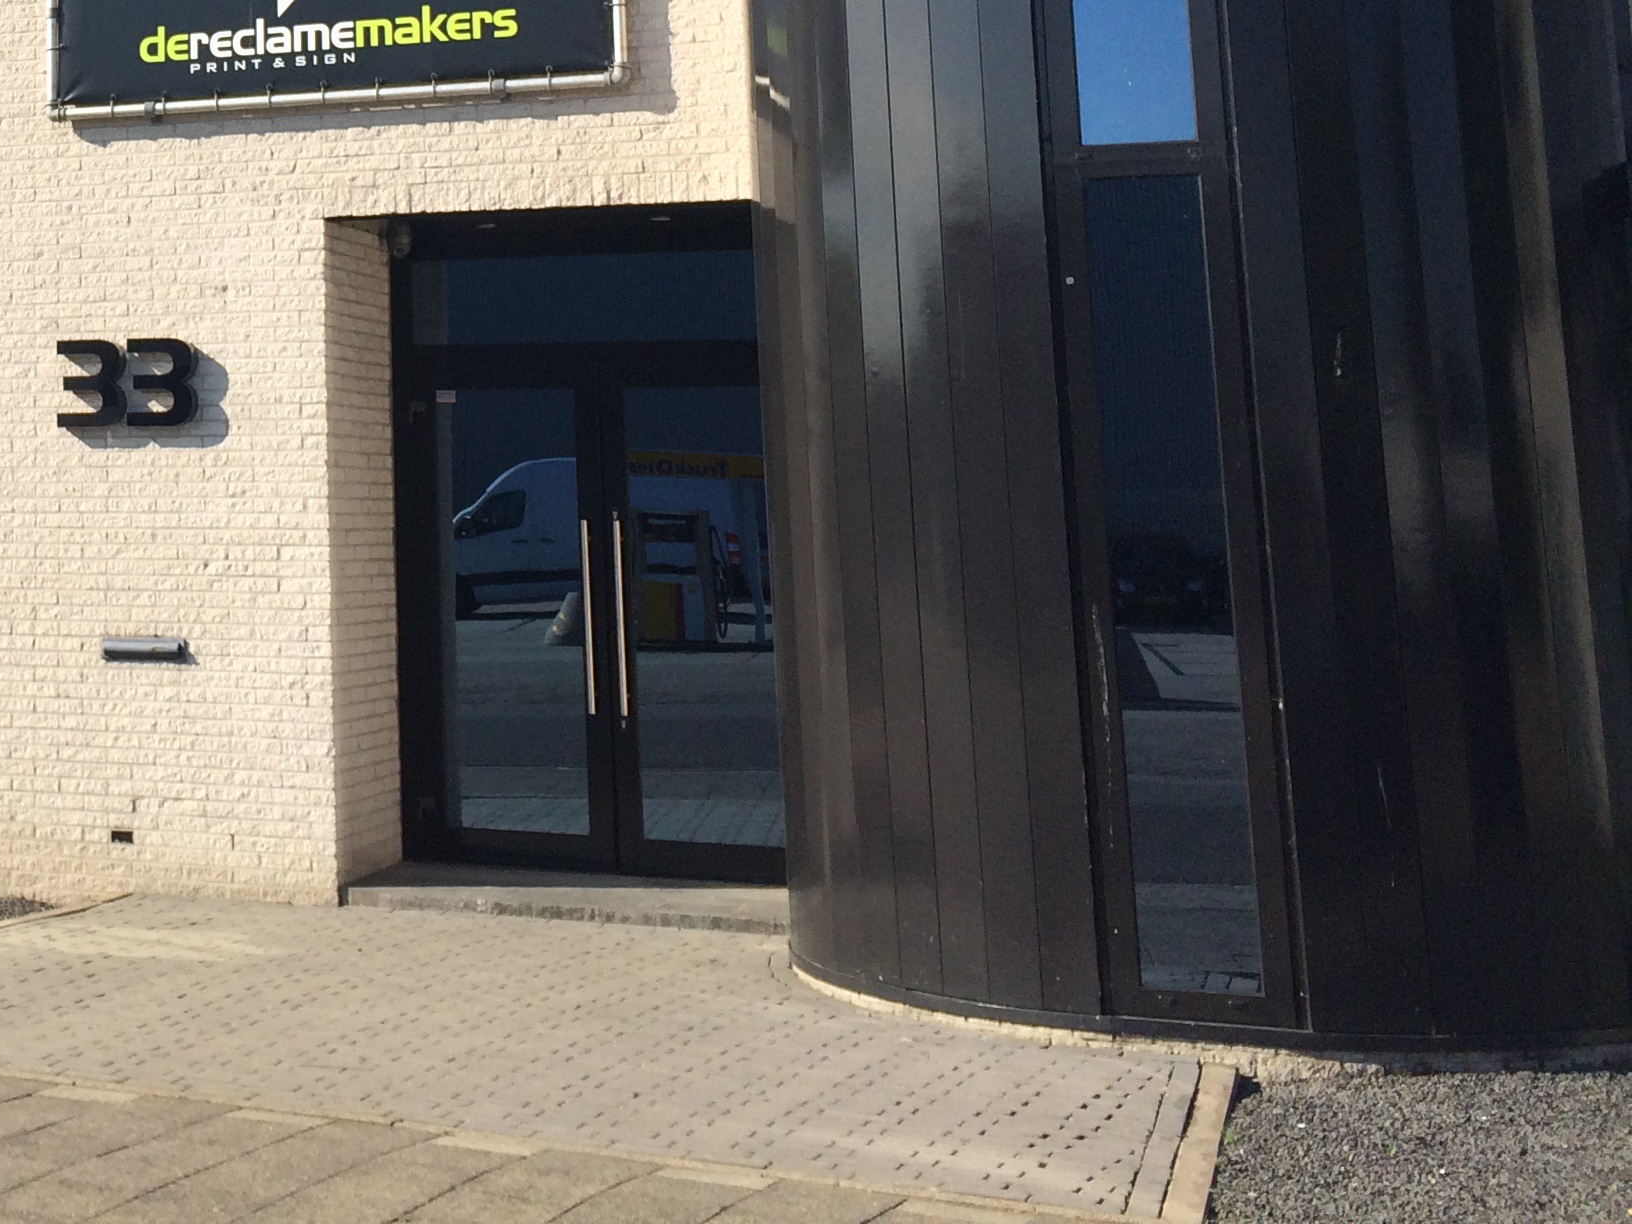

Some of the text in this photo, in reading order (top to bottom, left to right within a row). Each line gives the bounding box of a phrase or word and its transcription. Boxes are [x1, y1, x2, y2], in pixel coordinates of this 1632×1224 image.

[139, 5, 518, 63] dereclamemakers
[189, 52, 356, 75] PRINT & SIGN
[56, 338, 200, 428] 33
